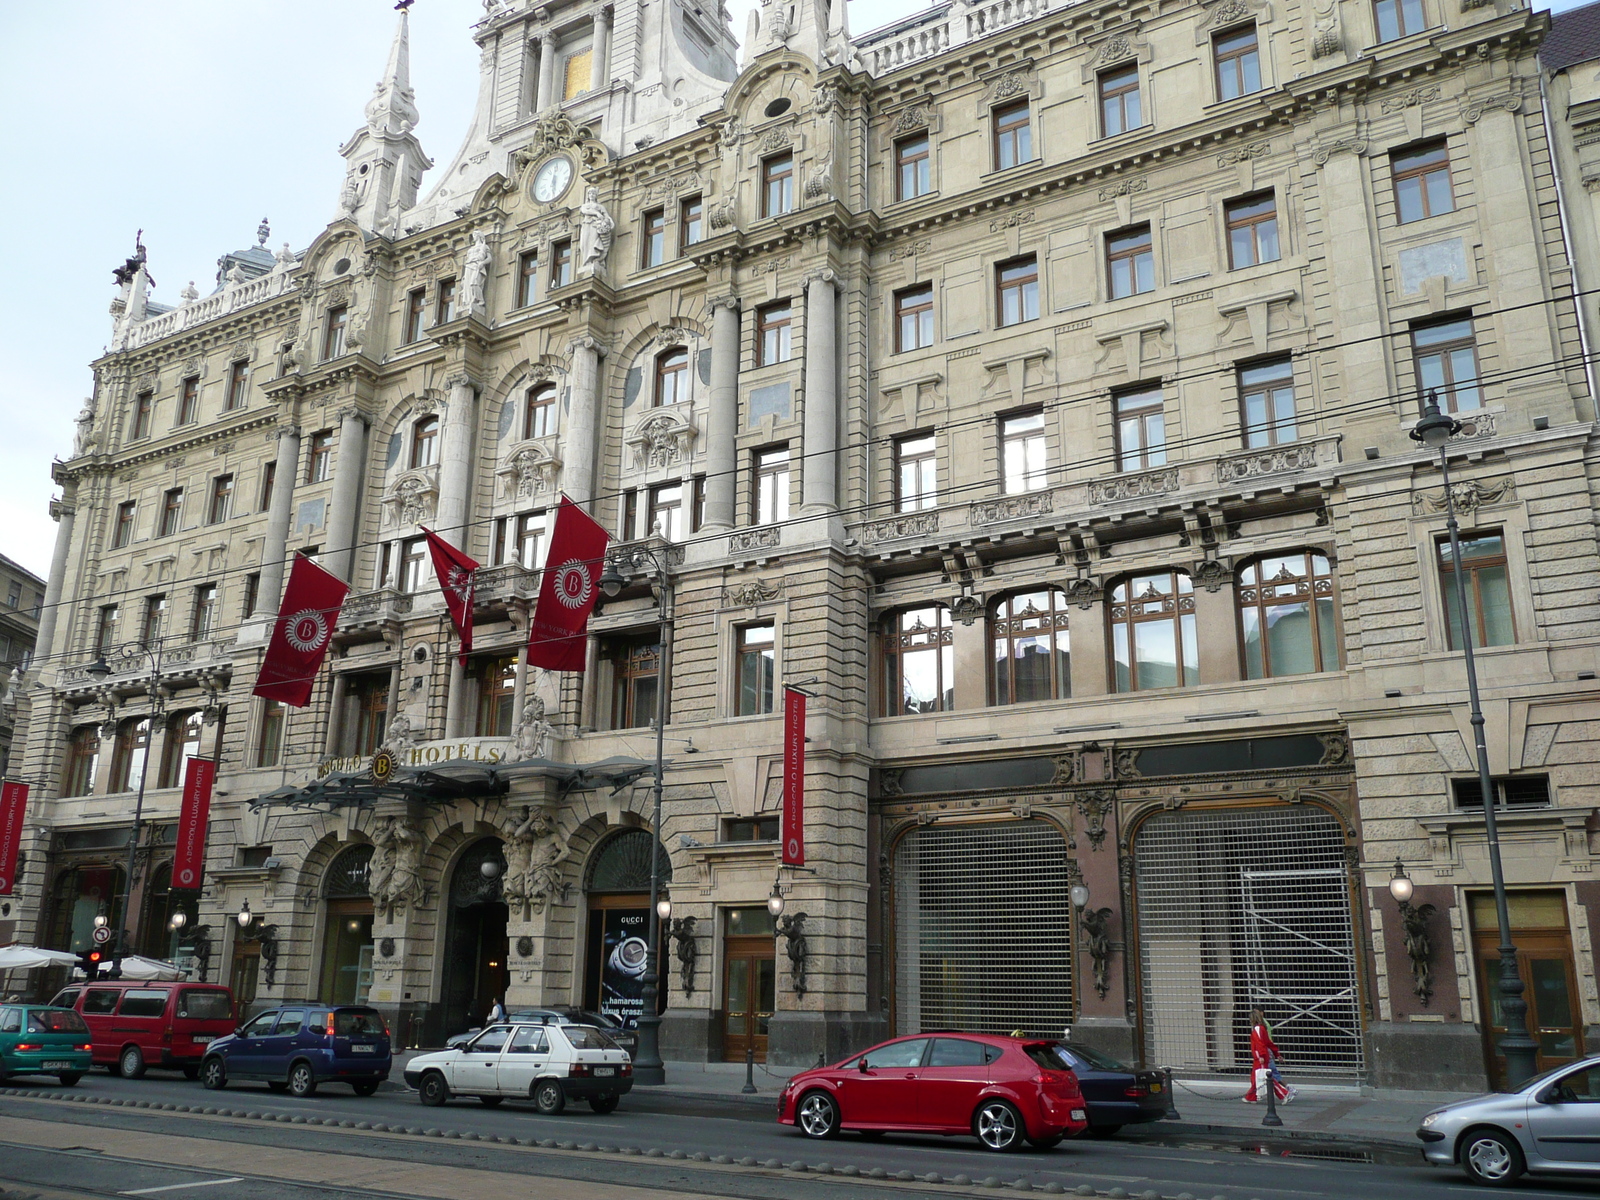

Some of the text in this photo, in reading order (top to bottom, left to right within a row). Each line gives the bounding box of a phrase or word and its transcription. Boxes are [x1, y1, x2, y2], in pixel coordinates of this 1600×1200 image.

[549, 624, 568, 635] YORK
[411, 743, 500, 763] HOTELS
[196, 764, 204, 788] HOTEL
[377, 759, 388, 774] B
[10, 787, 19, 808] HOTEL
[192, 789, 201, 819] LUXURY
[6, 808, 15, 834] LUXURY
[187, 820, 197, 856] BOSCOLO
[1, 835, 11, 867] BOSCOLO
